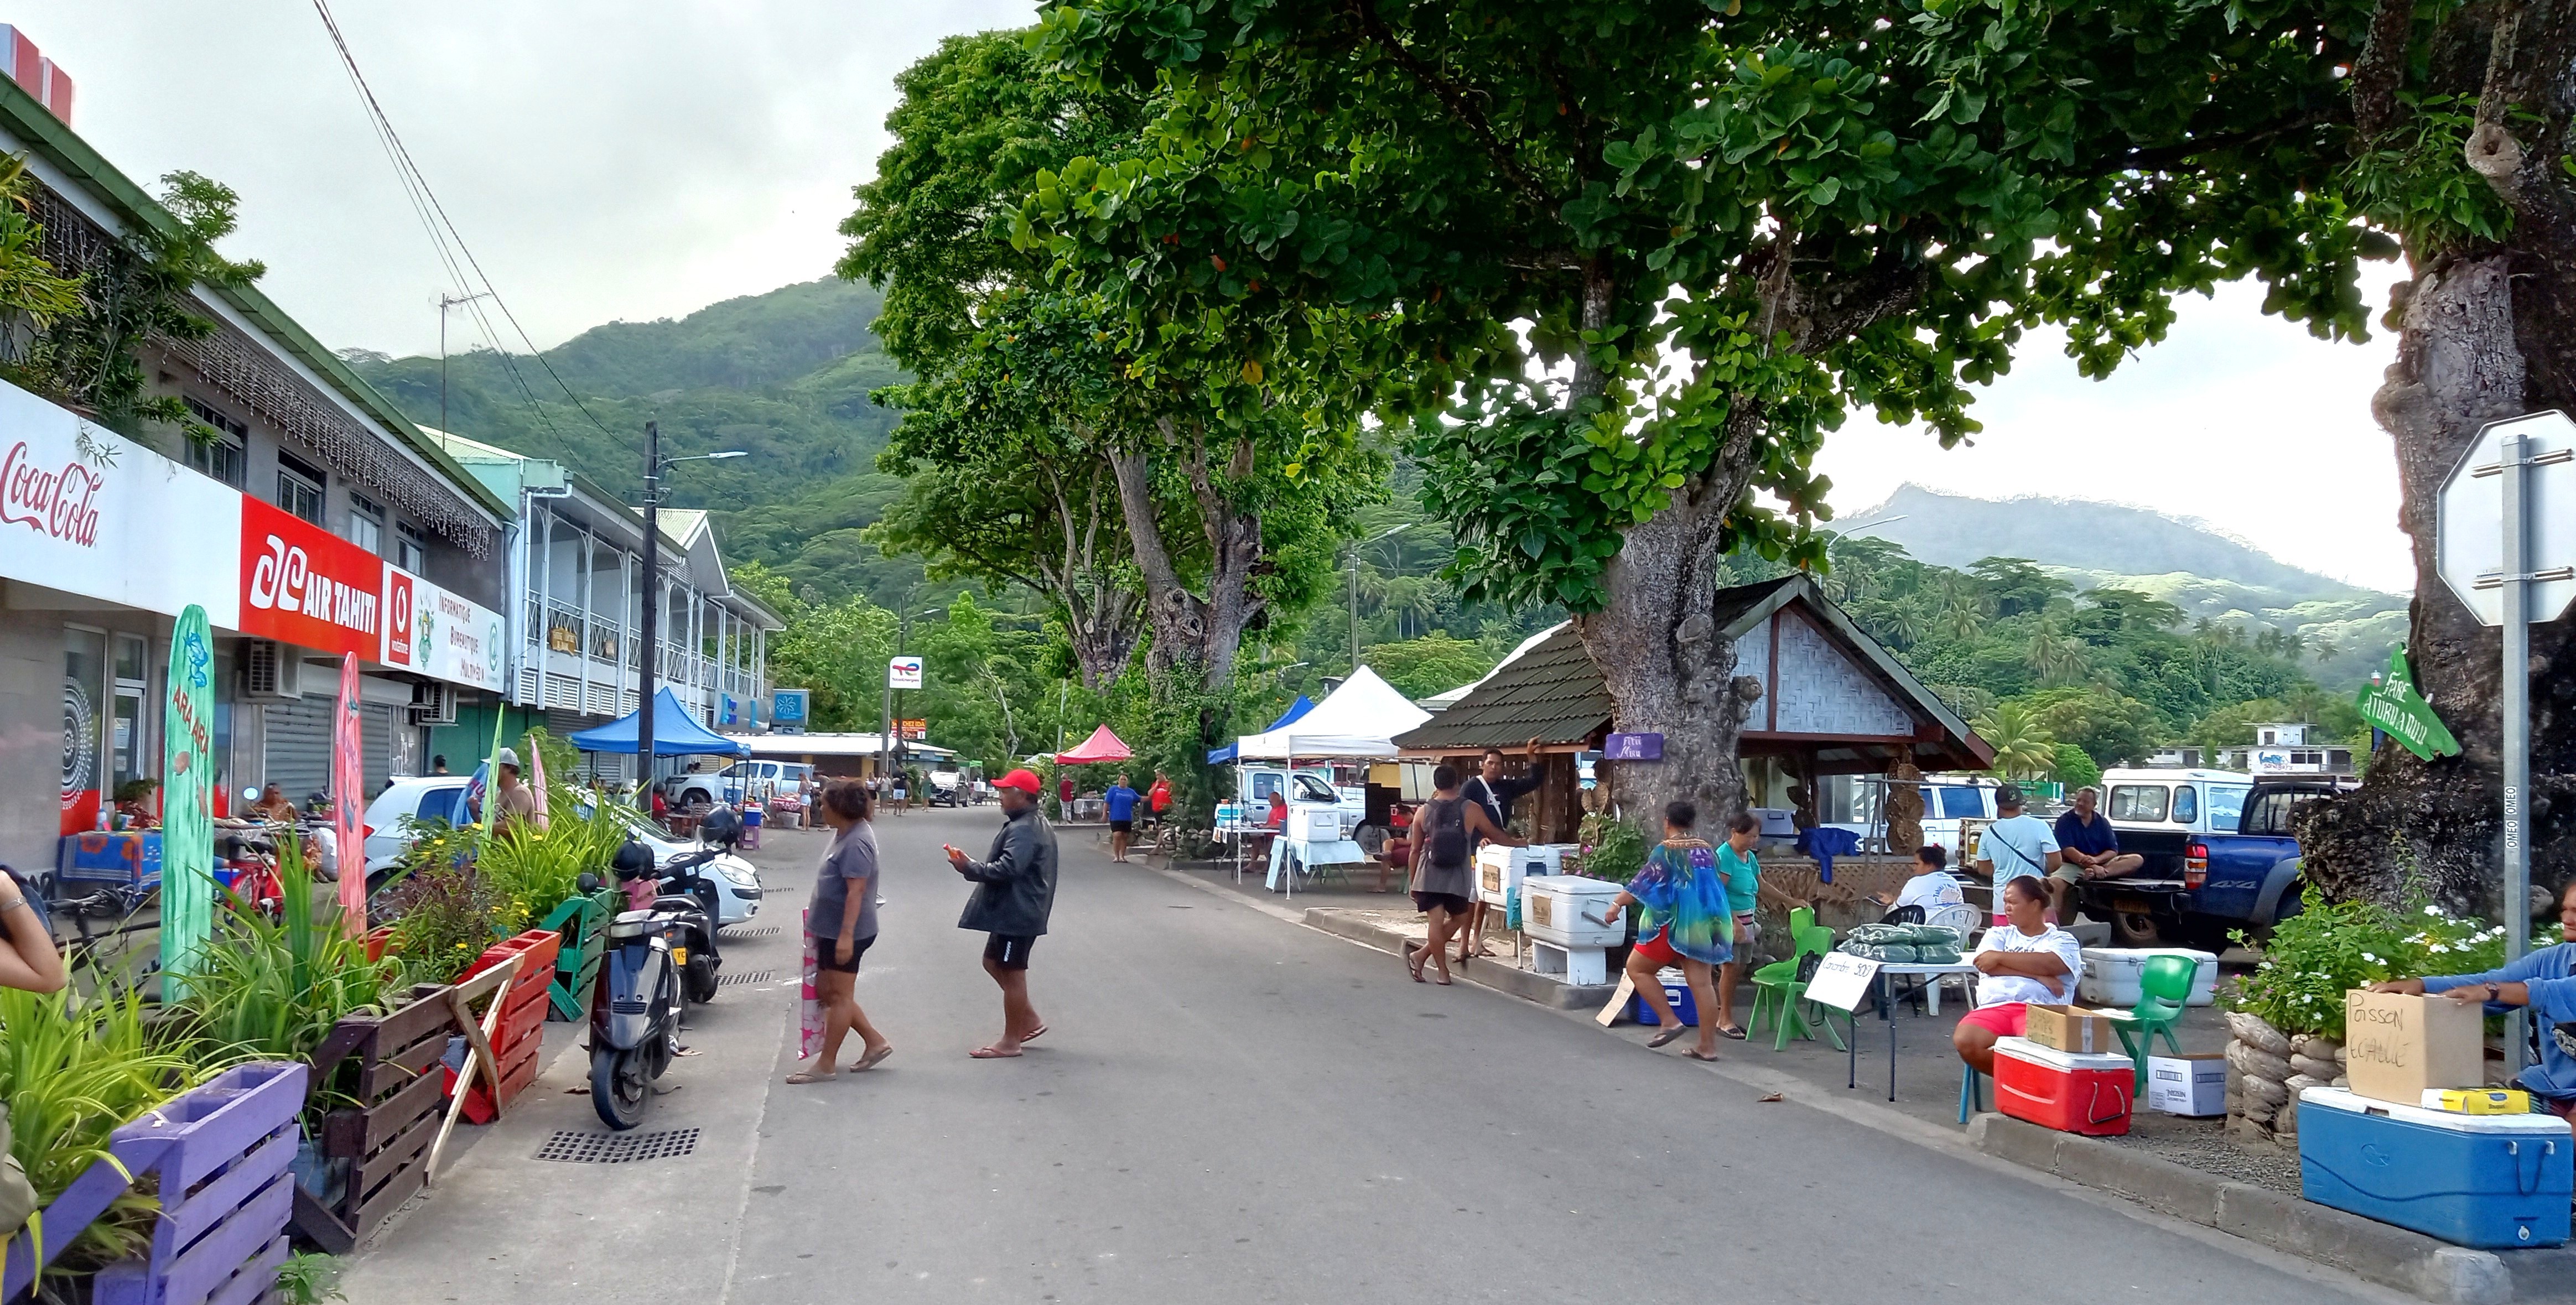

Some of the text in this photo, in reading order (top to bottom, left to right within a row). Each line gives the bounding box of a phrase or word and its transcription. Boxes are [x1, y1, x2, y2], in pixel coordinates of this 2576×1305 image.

[302, 571, 376, 635] AIR TAHITI
[173, 684, 209, 758] ARA ARA
[2506, 788, 2516, 814] OMEO
[2506, 821, 2517, 848] OMEO
